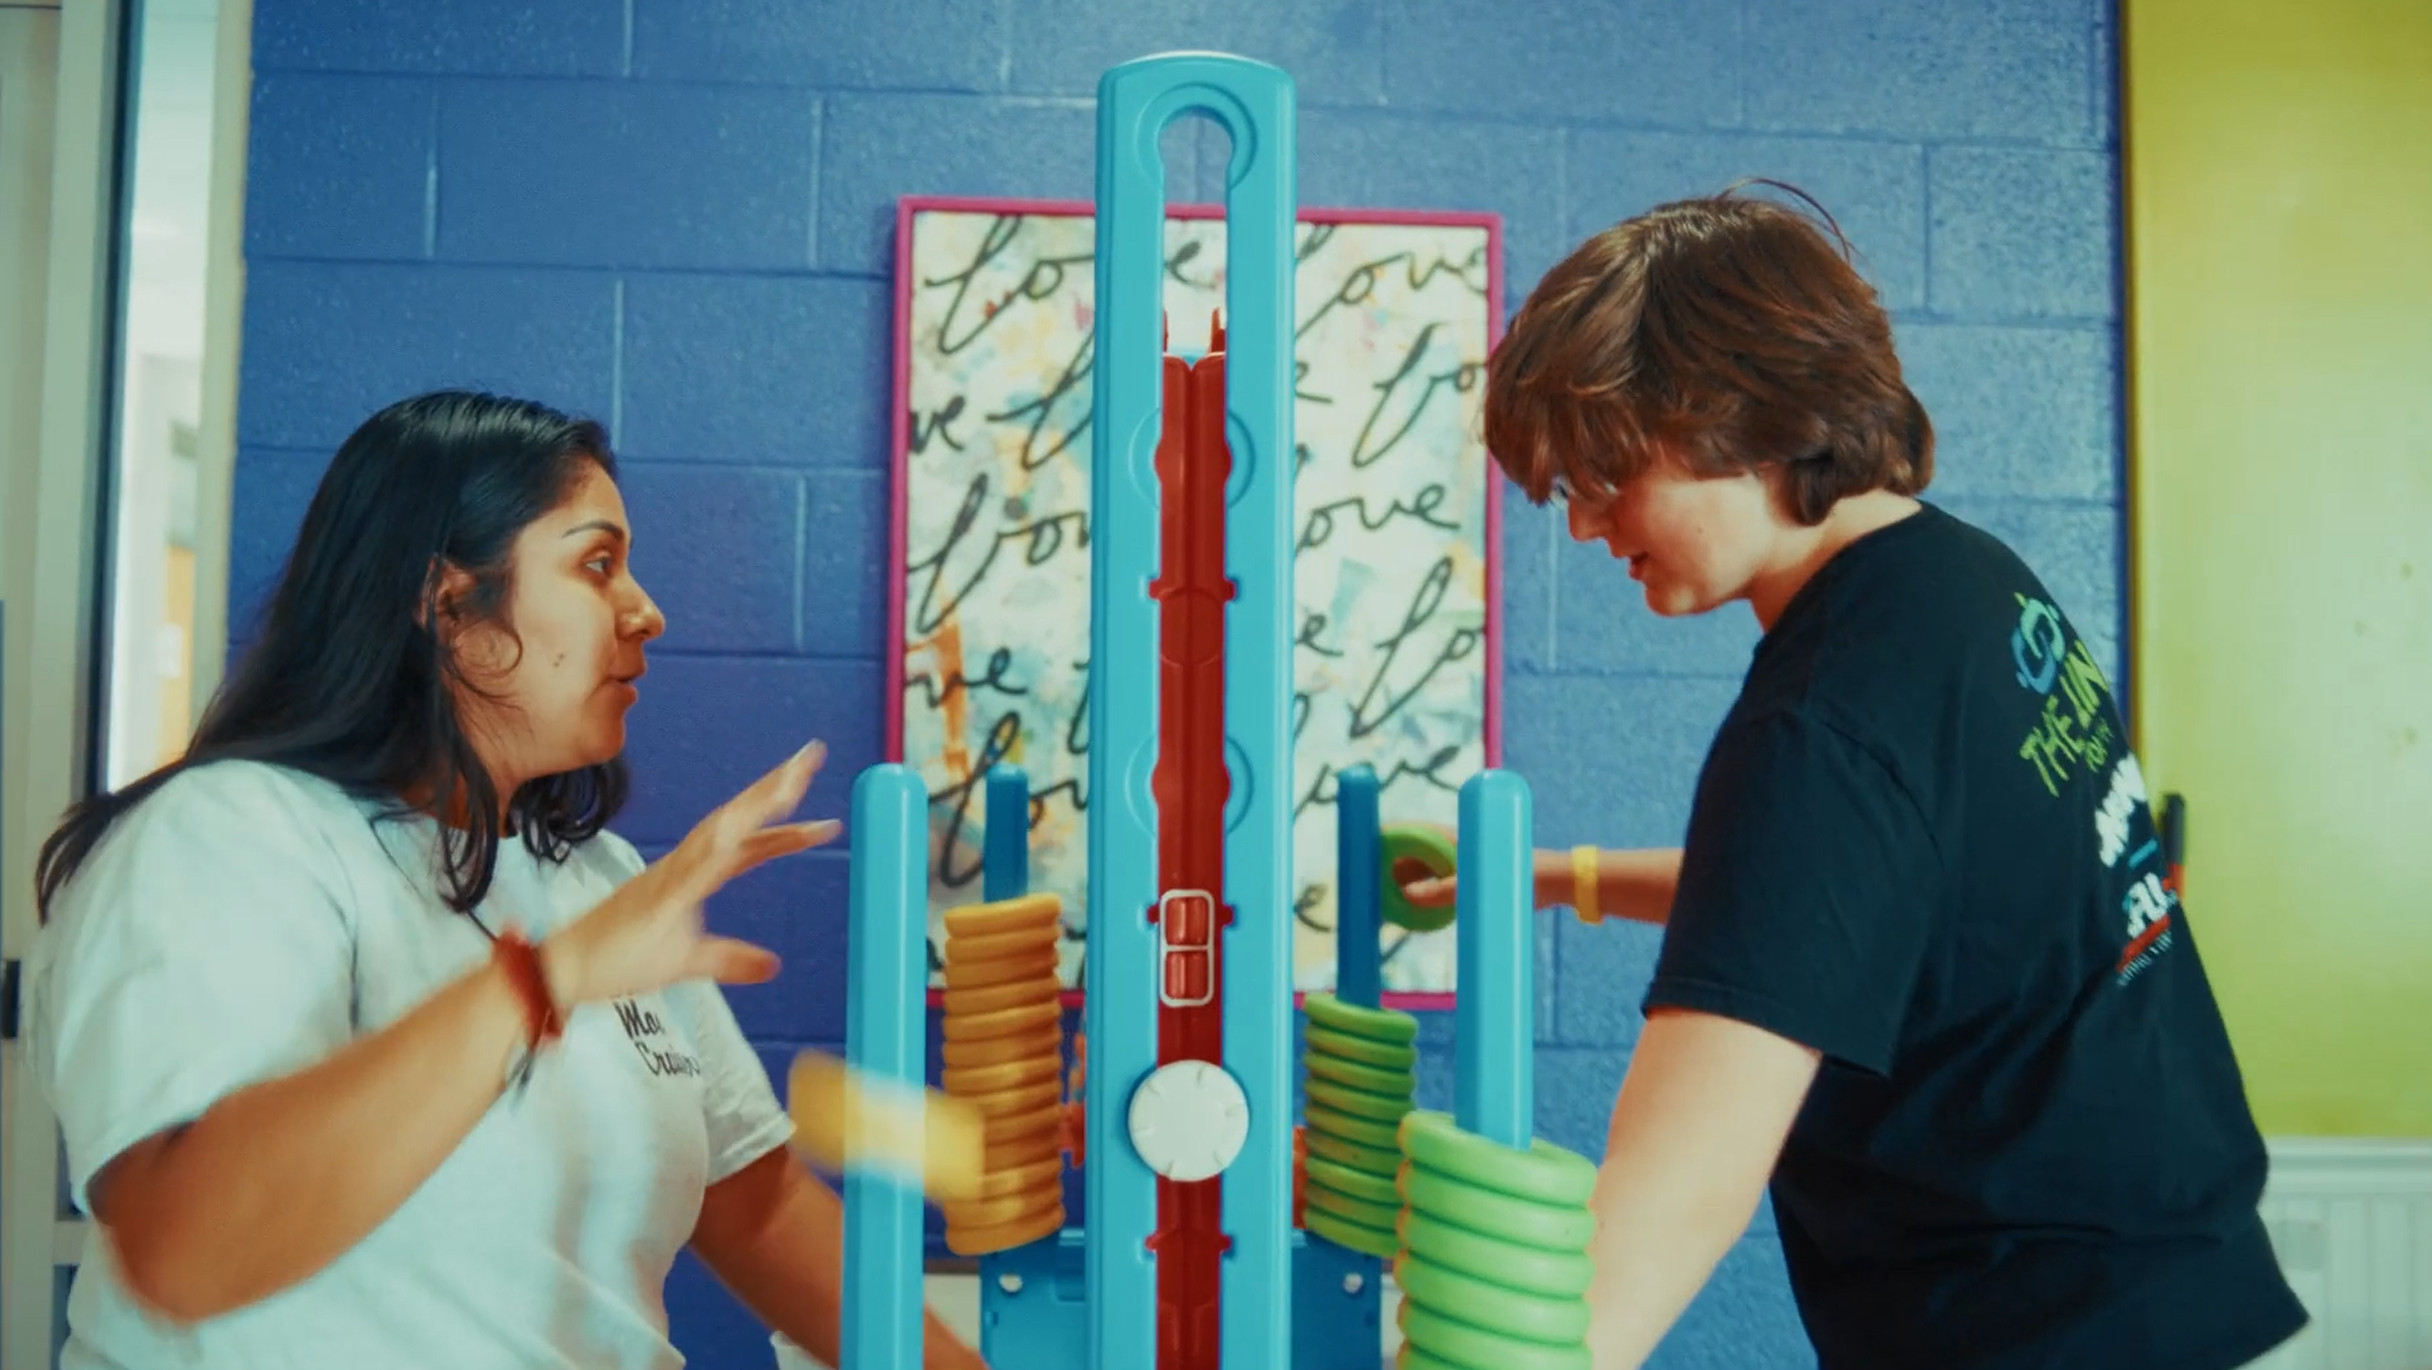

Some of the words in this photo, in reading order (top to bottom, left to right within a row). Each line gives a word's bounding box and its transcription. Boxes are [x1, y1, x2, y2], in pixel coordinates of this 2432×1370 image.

[1295, 484, 1461, 557] ove
[2019, 694, 2086, 798] THE
[2059, 639, 2109, 730] LIN
